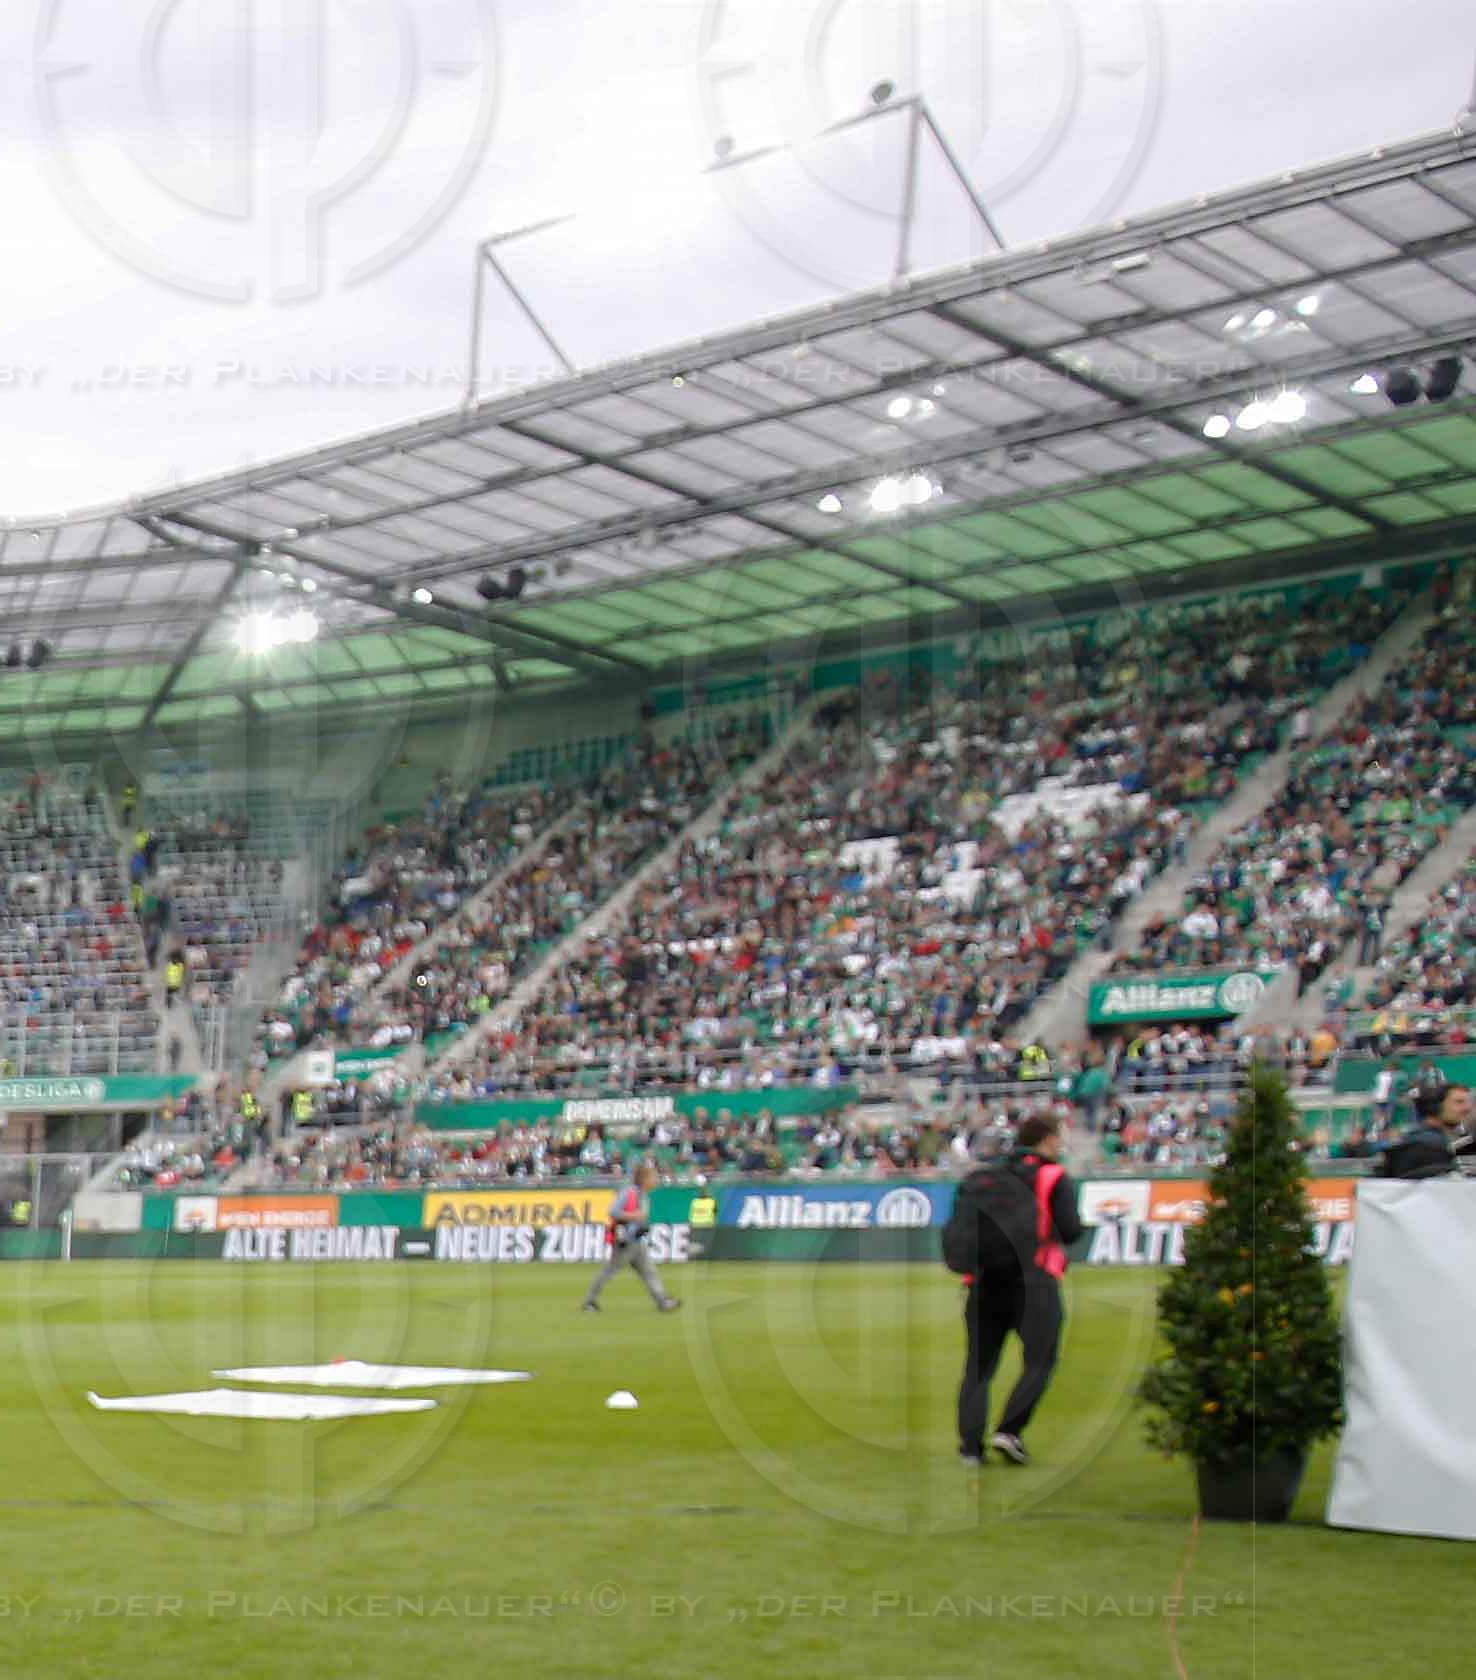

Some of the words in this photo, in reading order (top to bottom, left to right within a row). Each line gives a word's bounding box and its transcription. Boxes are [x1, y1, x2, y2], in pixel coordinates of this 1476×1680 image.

[737, 1194, 871, 1228] Allianz
[221, 1227, 287, 1260] ALTE
[291, 1225, 401, 1260] HEIMAT
[434, 1225, 534, 1260] NEUES
